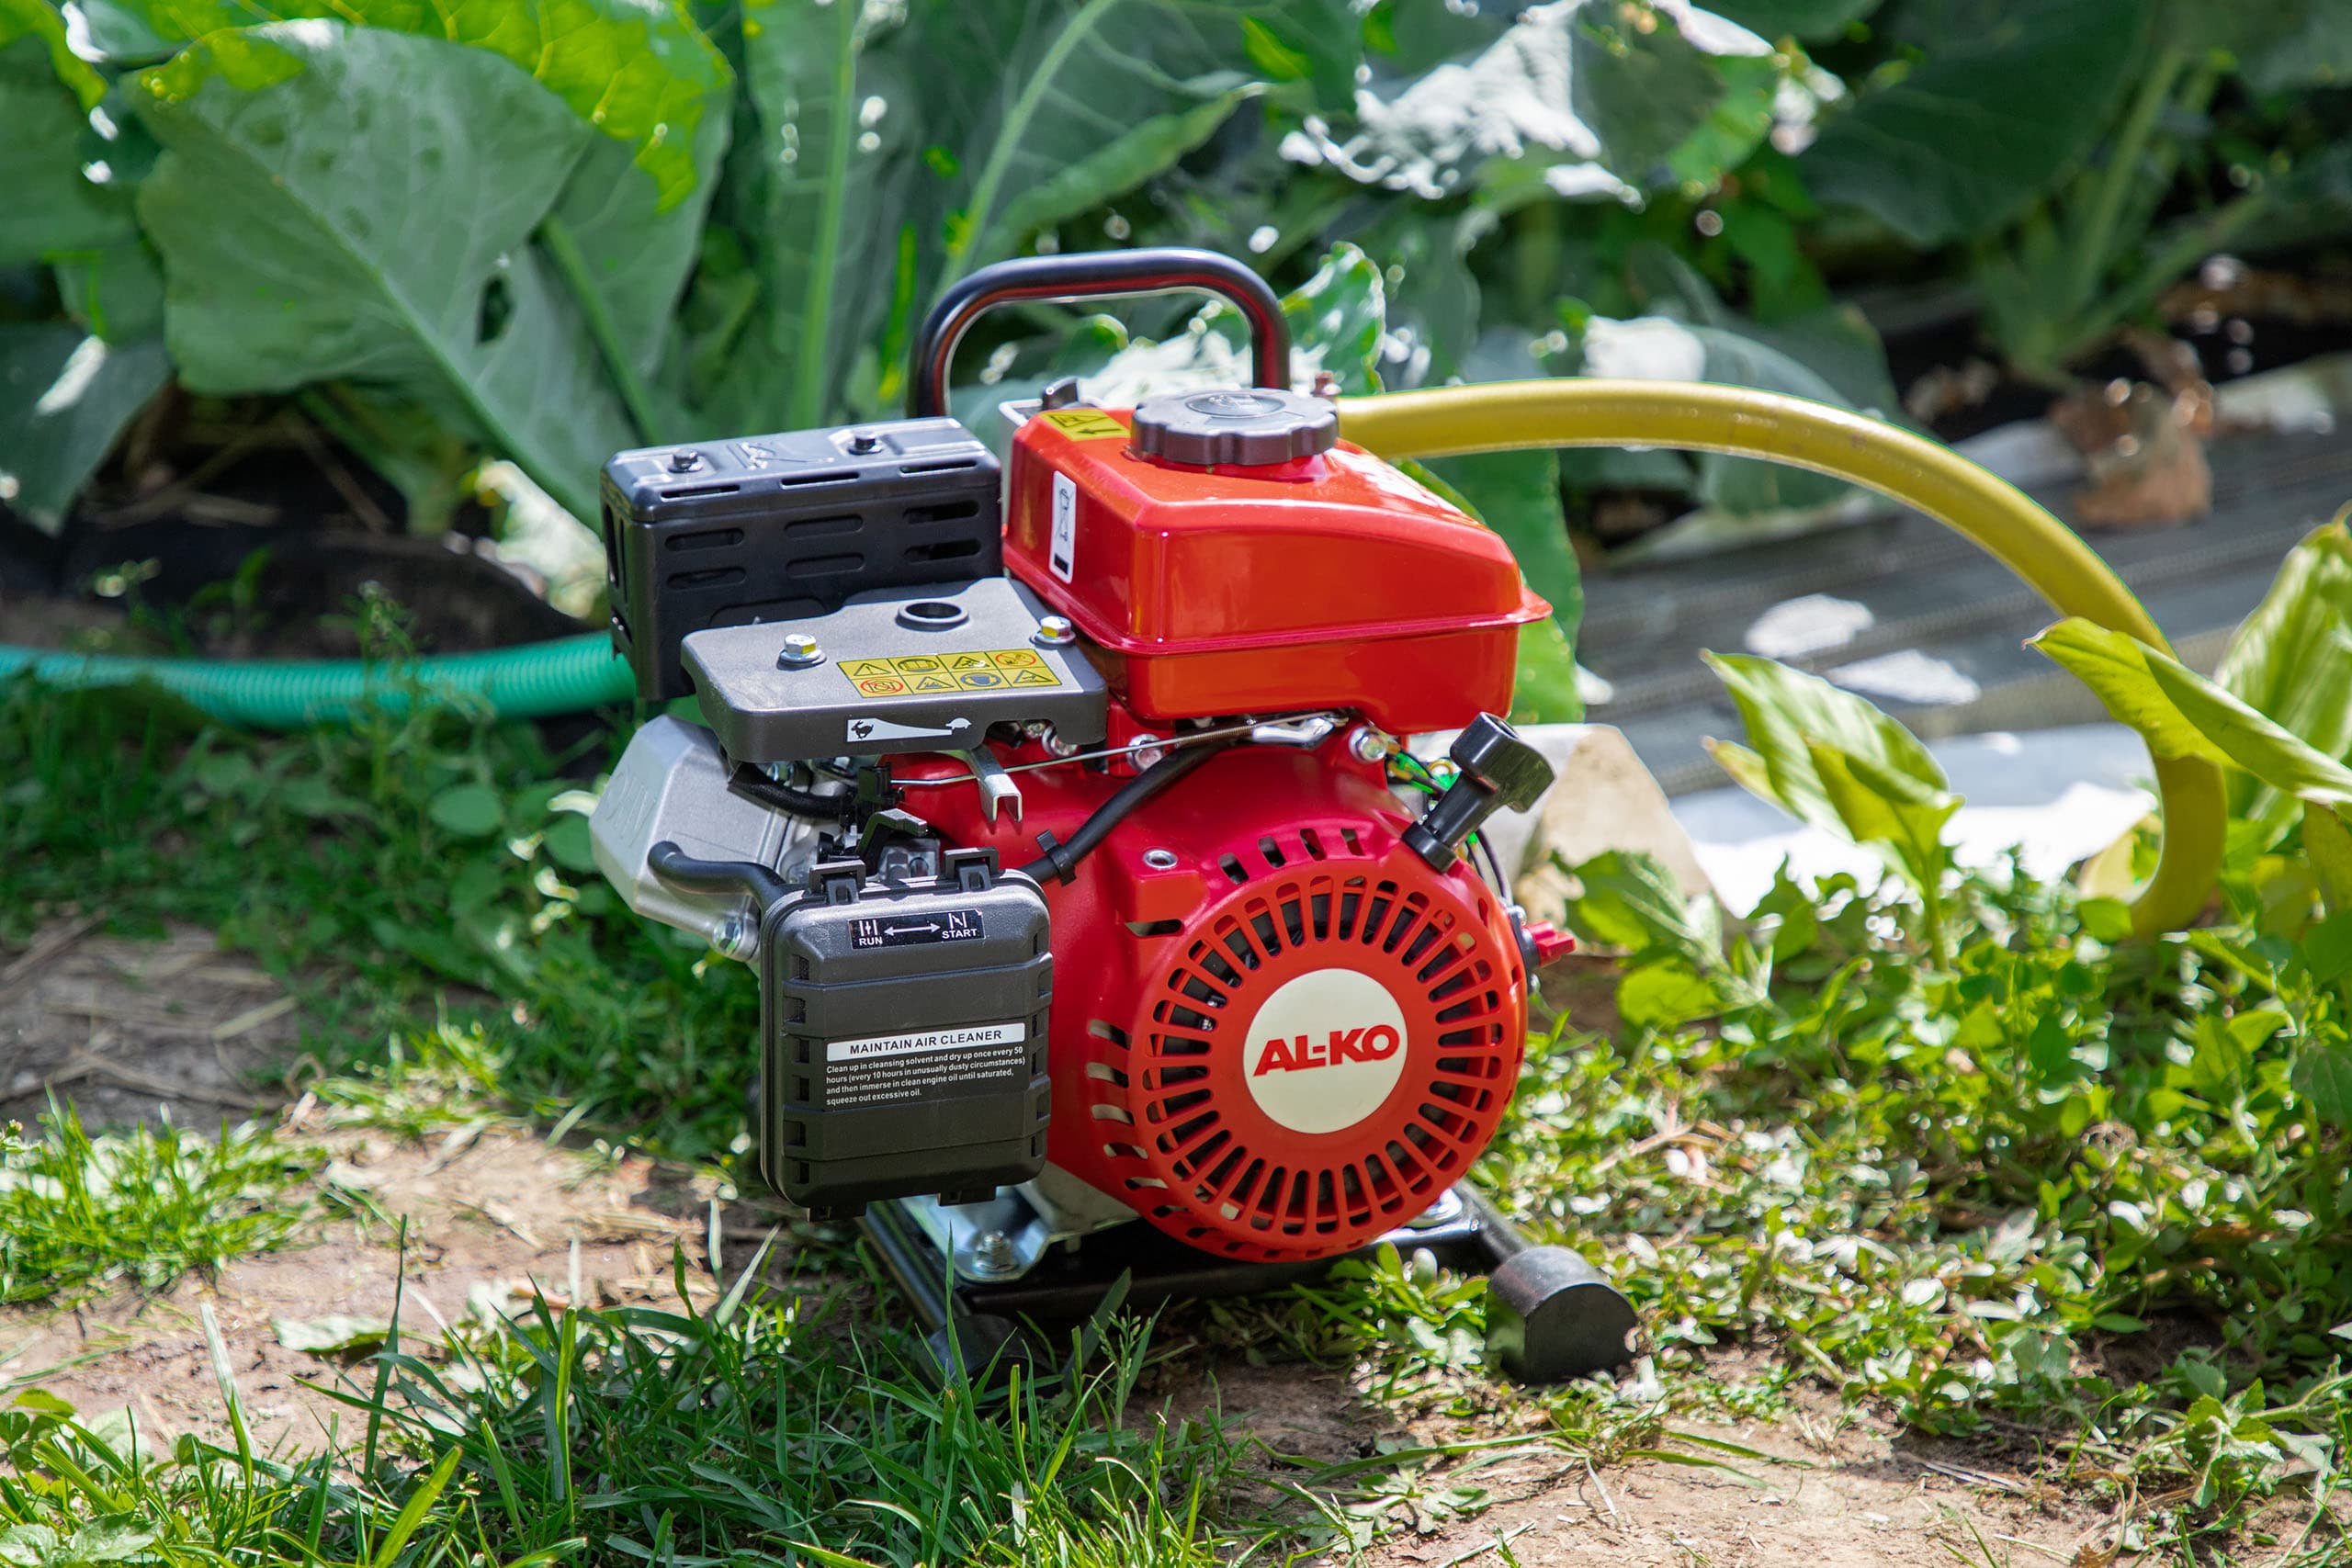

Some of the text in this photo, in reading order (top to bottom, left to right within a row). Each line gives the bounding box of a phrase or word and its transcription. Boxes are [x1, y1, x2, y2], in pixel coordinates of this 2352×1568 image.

[859, 936, 883, 946] RUN
[942, 928, 978, 939] START
[850, 1030, 1002, 1055] MAINTAIN AIR CLEANER
[1252, 1024, 1400, 1077] AL-KO
[826, 1076, 848, 1084] hours
[848, 1073, 871, 1083] (every
[882, 1069, 903, 1077] hours
[904, 1067, 911, 1076] in
[912, 1064, 948, 1075] unusually
[948, 1062, 969, 1071] dusty
[970, 1056, 1025, 1069] circumstances)
[827, 1066, 848, 1074] Clean
[868, 1059, 905, 1069] cleansing
[905, 1055, 933, 1065] solvent
[933, 1054, 948, 1062] and
[949, 1053, 962, 1061] dry
[973, 1050, 992, 1058] once
[992, 1048, 1013, 1057] every
[1013, 1046, 1023, 1055] 50
[826, 1086, 841, 1095] and
[841, 1084, 858, 1092] then
[859, 1081, 891, 1091] immerse
[900, 1077, 922, 1087] clean
[922, 1075, 947, 1086] engine
[948, 1073, 957, 1082] oil
[958, 1071, 976, 1080] until
[826, 1089, 922, 1106] squeeze out excessive oil.
